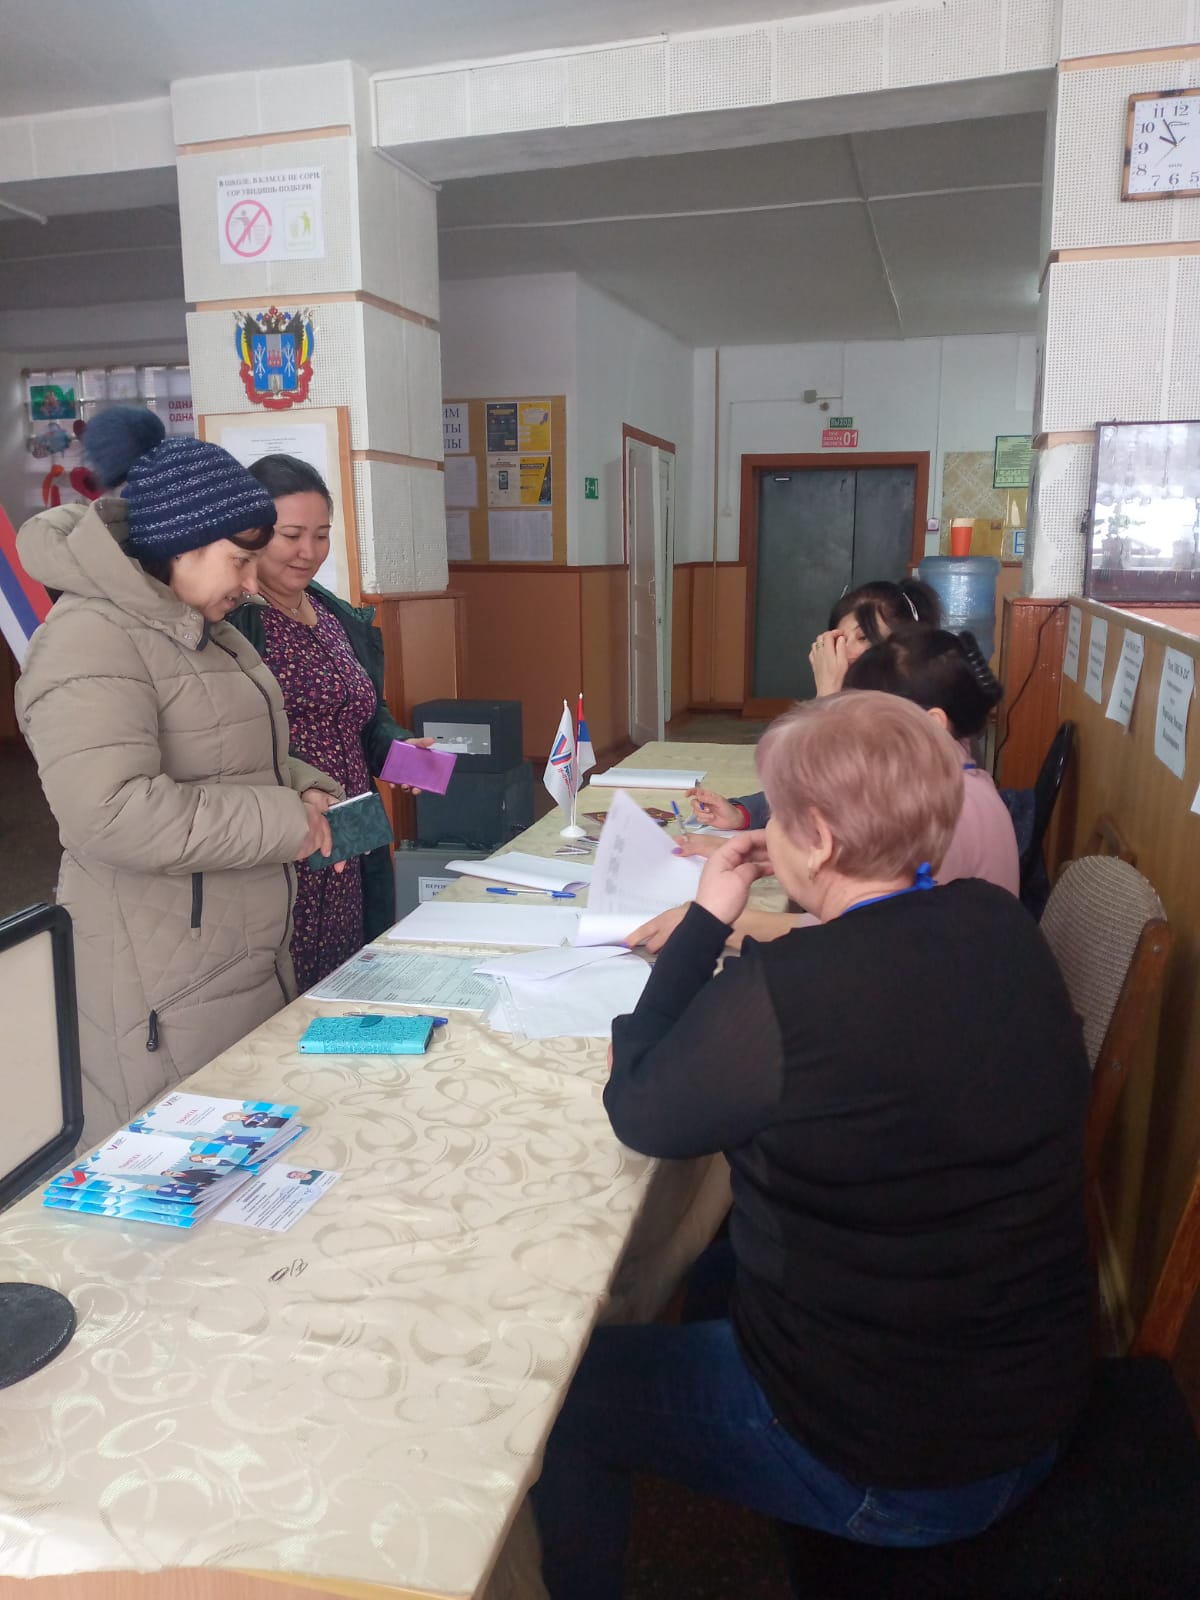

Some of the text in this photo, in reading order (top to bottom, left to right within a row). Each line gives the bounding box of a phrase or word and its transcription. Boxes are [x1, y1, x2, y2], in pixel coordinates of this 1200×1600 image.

[1174, 105, 1190, 117] 12
[1141, 121, 1156, 134] 10
[1138, 142, 1149, 155] 9
[1136, 163, 1147, 176] 8
[1151, 171, 1200, 187] 7 6 5
[843, 432, 858, 446] 01
